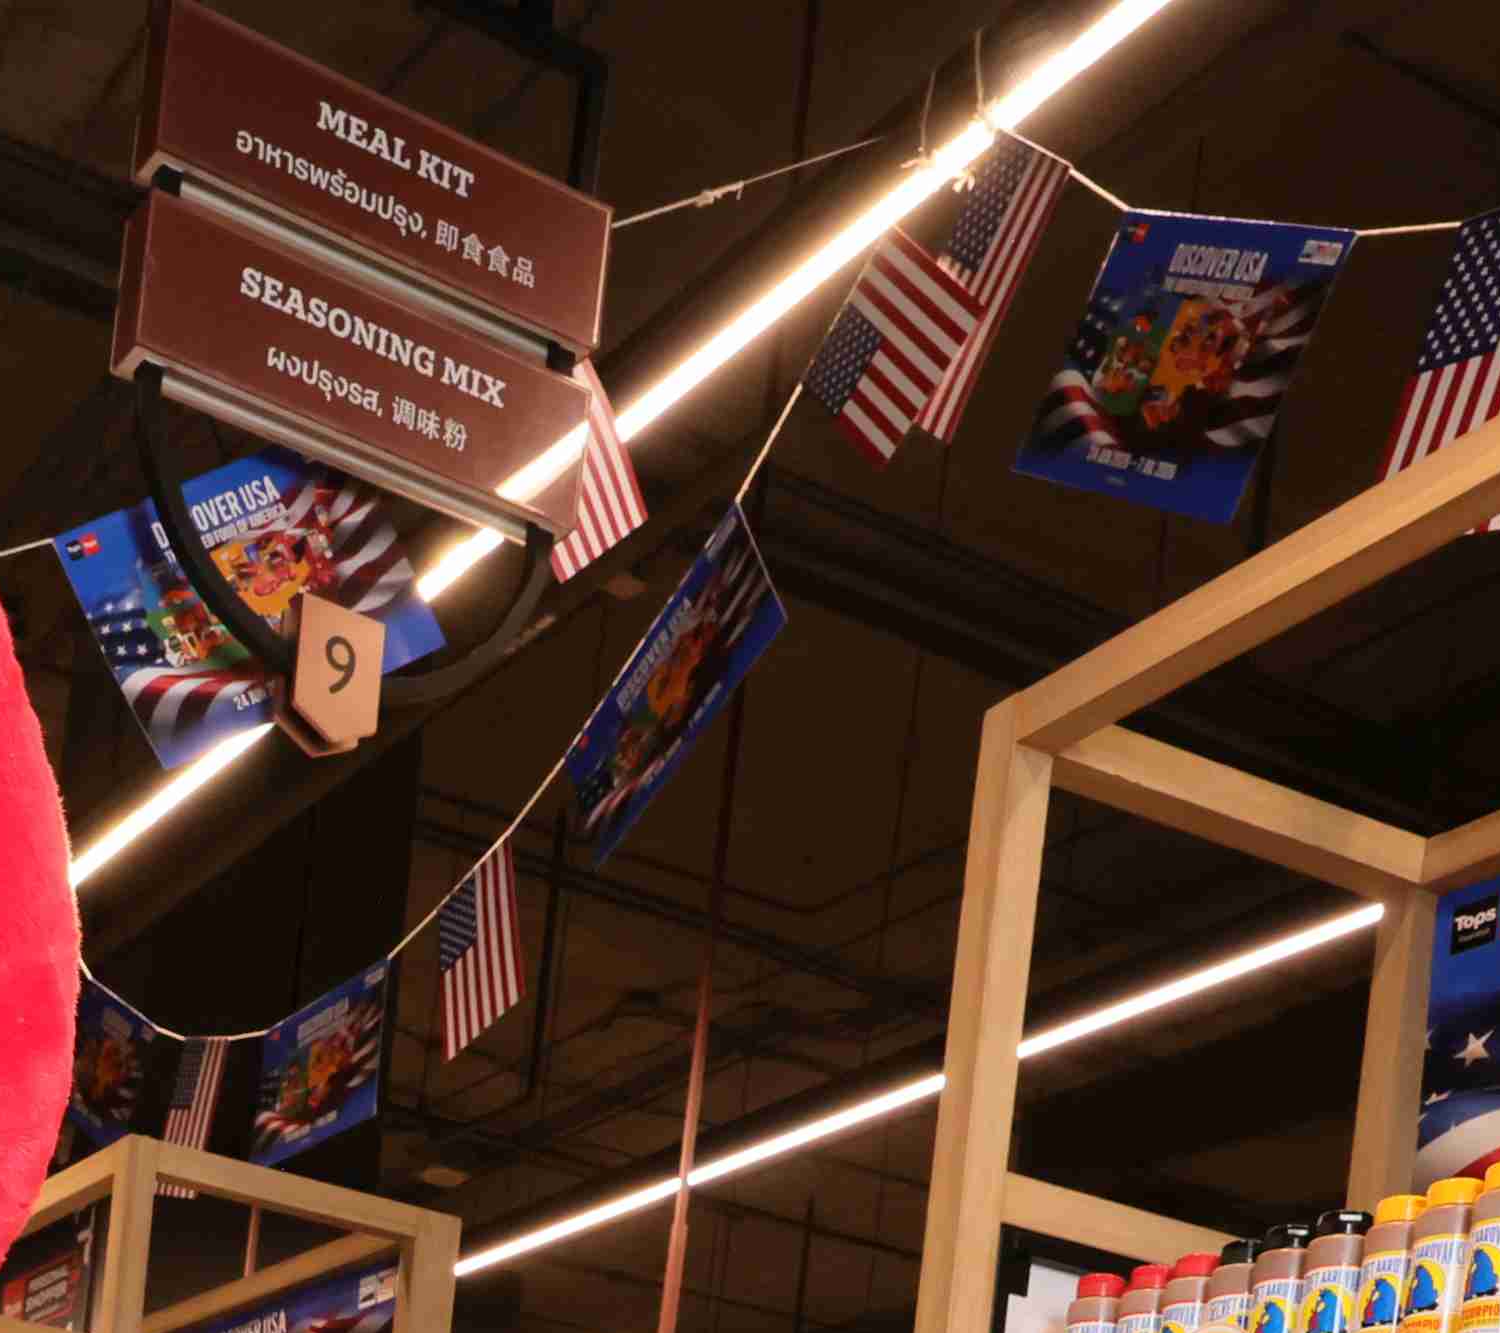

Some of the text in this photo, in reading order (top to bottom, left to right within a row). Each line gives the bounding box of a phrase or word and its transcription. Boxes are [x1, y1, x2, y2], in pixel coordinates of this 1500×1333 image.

[317, 101, 475, 198] MEAL KIT
[435, 219, 535, 288] 即食食品
[240, 267, 506, 408] SEASONING MIX
[392, 395, 468, 451] 调味粉
[325, 636, 356, 694] 9
[1453, 906, 1498, 933] Tops
